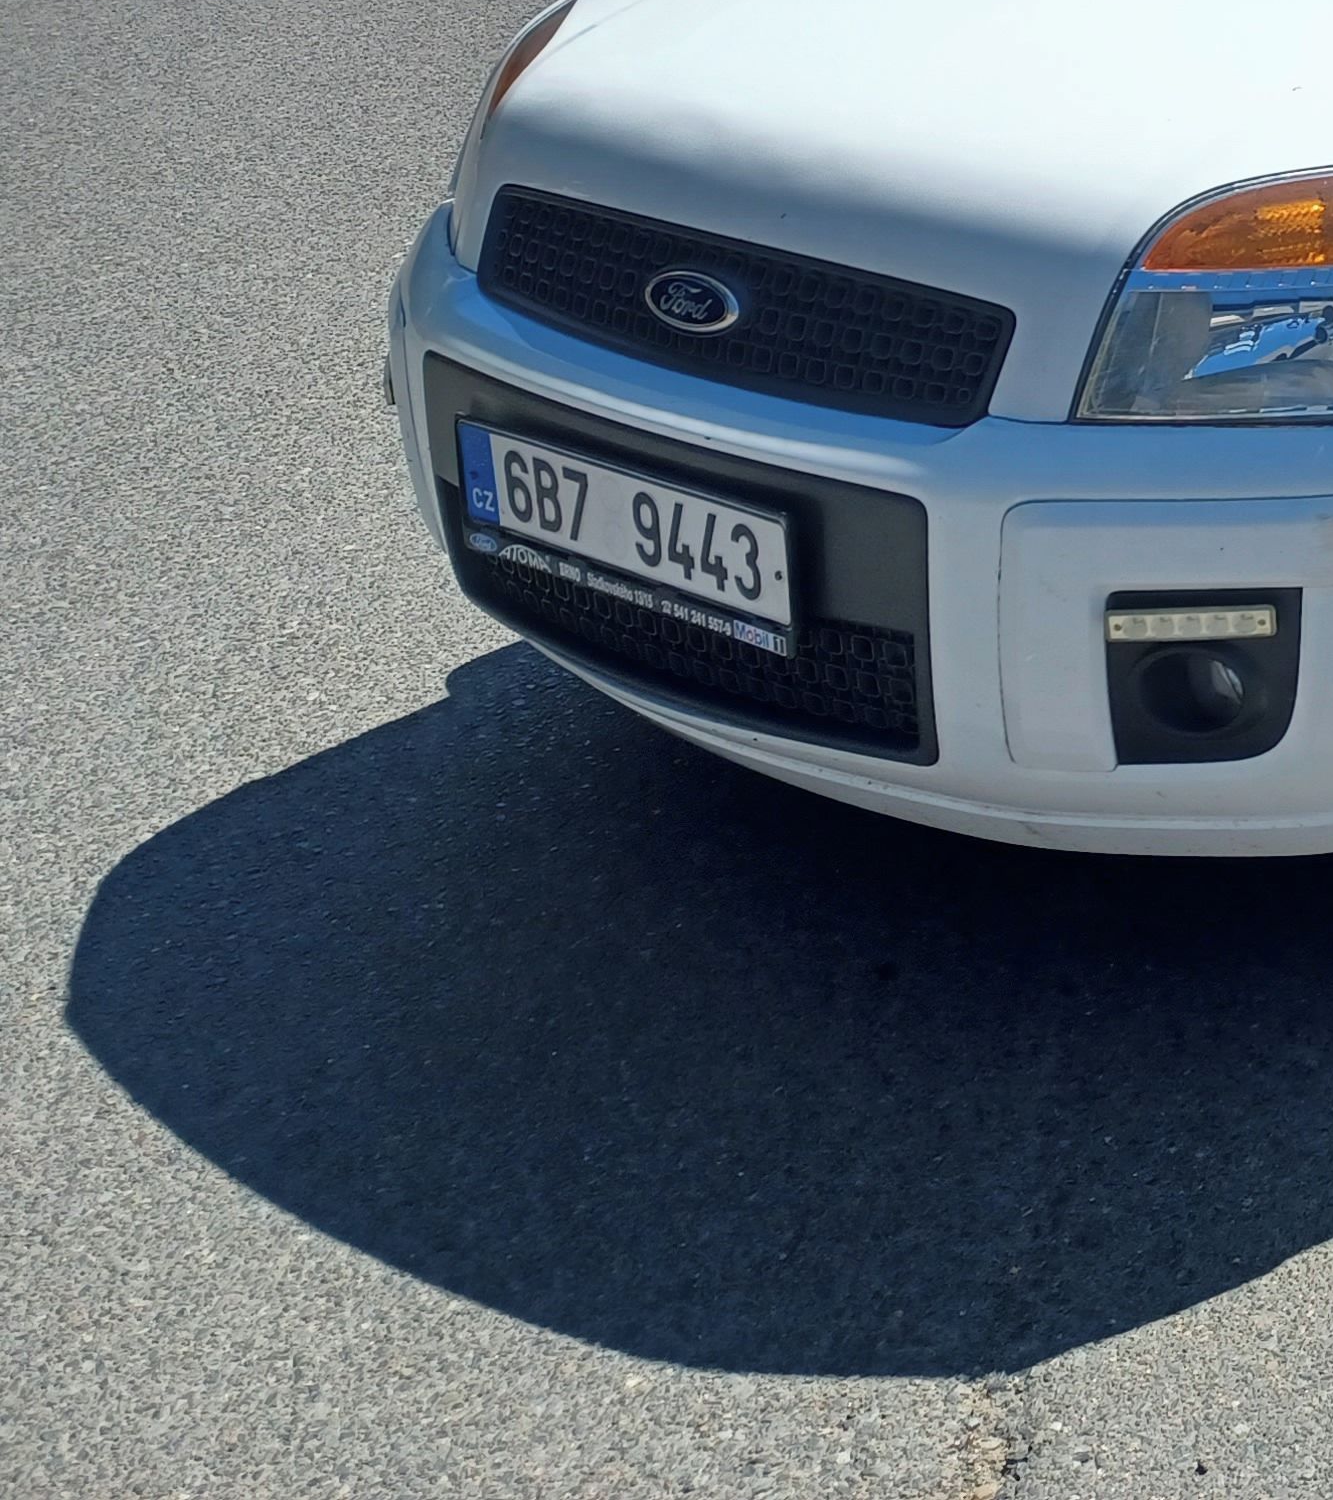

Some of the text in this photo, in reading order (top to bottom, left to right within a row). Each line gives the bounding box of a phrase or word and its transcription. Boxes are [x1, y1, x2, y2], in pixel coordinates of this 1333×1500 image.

[660, 281, 712, 320] Ford
[471, 450, 761, 601] CZ 6B7 9443
[735, 621, 770, 649] Mobil
